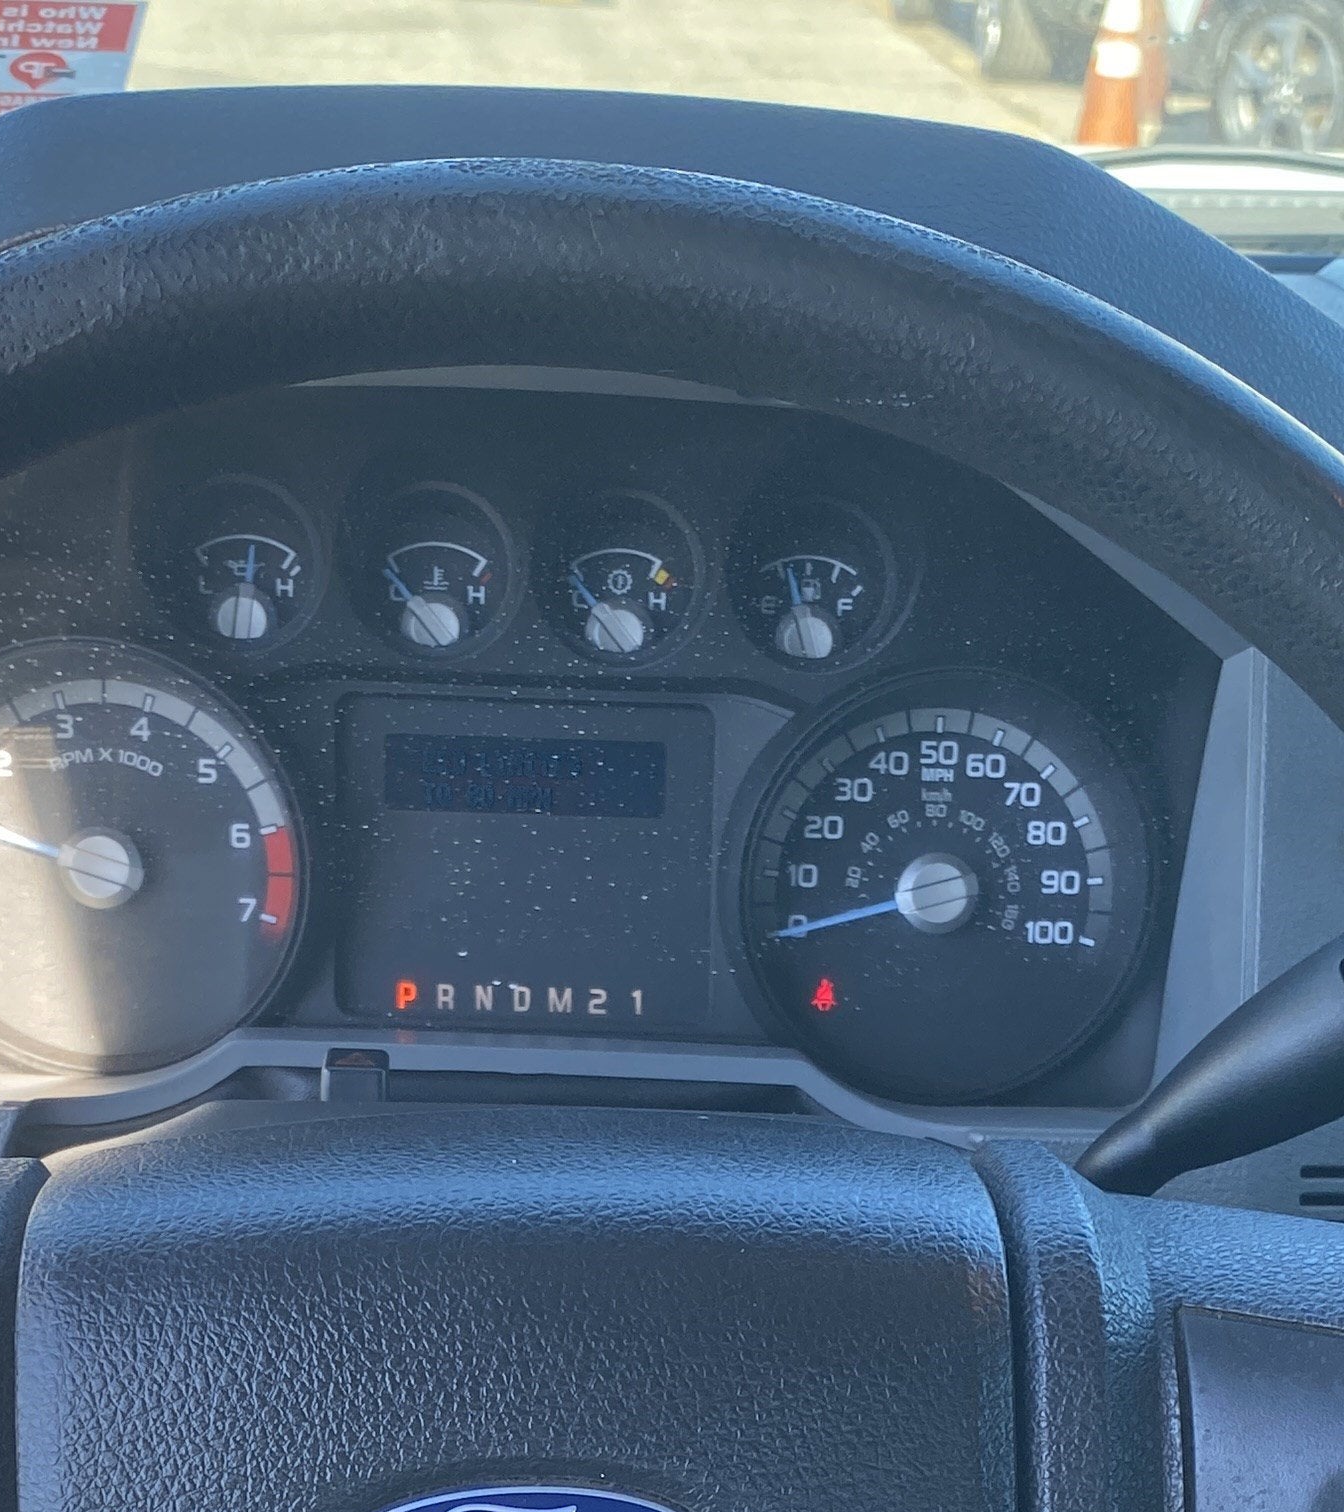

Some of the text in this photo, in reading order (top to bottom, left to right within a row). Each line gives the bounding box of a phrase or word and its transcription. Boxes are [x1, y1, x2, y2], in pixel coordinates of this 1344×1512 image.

[275, 577, 295, 598] H
[466, 585, 487, 605] H
[647, 591, 668, 611] H
[836, 598, 854, 617] F
[56, 713, 75, 739] 3
[130, 717, 152, 742] 4
[48, 747, 164, 777] RPM X 1000
[868, 751, 910, 776] 40
[919, 740, 959, 765] 50
[197, 758, 218, 785] 5
[920, 767, 955, 783] MPH
[964, 753, 1007, 781] 60
[834, 776, 874, 803] 30
[920, 786, 953, 802] km/h
[1003, 781, 1042, 808] 70
[886, 809, 911, 831] 60
[924, 802, 949, 818] 80
[958, 808, 988, 833] 100
[229, 822, 252, 849] 6
[803, 815, 845, 840] 20
[1026, 820, 1068, 846] 80
[858, 830, 882, 855] 40
[988, 830, 1012, 860] 120
[788, 863, 819, 889] 10
[1004, 864, 1023, 895] 140
[1040, 869, 1081, 896] 90
[237, 898, 257, 923] 7
[1024, 919, 1074, 946] 100
[394, 980, 644, 1016] P R N D M 2 1
